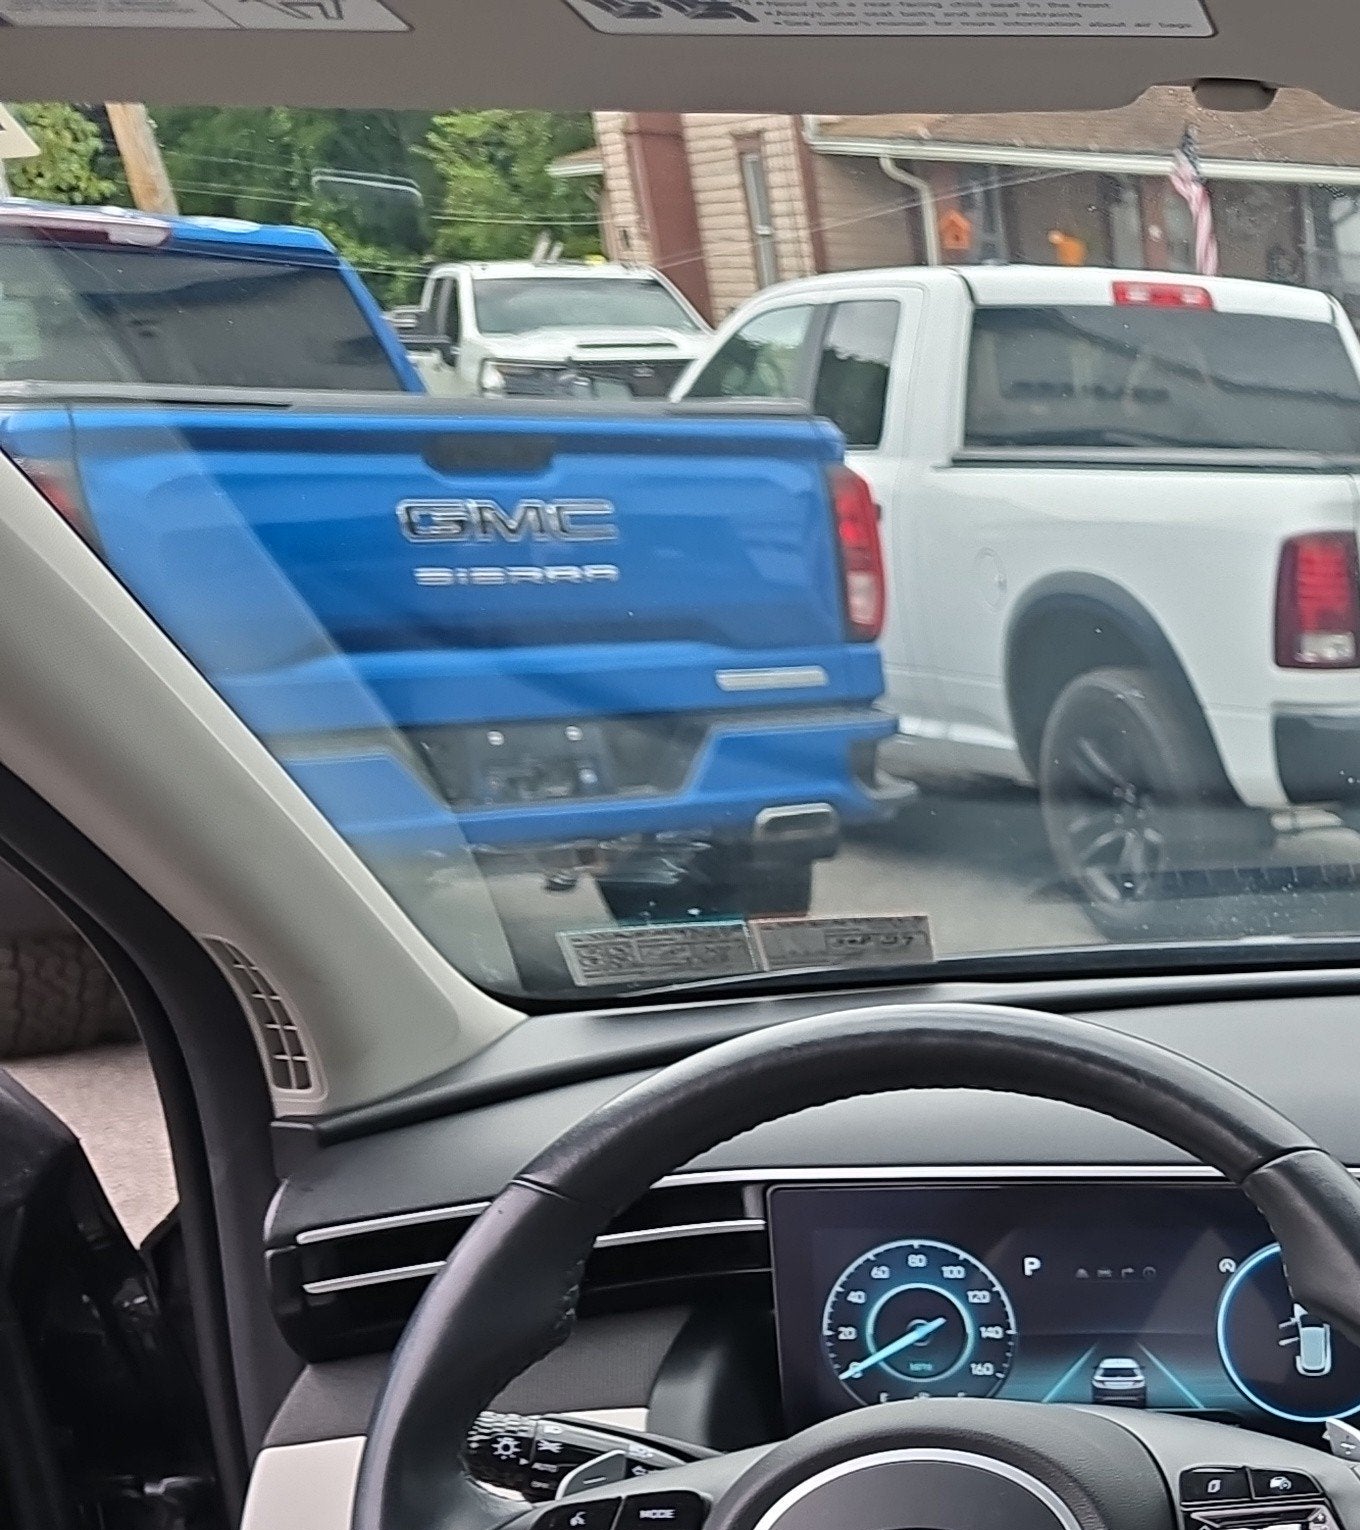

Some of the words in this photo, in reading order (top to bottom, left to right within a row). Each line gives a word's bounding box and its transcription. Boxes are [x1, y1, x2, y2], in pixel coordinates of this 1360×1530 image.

[396, 498, 619, 543] GMC
[412, 563, 619, 587] SIERRA
[907, 1253, 928, 1268] 80
[1023, 1256, 1042, 1277] P
[870, 1265, 891, 1279] 60
[941, 1265, 966, 1279] 100
[846, 1290, 867, 1304] 40
[966, 1290, 991, 1304] 120
[837, 1326, 858, 1340] 20
[979, 1325, 1004, 1339] 140
[970, 1362, 995, 1376] 160
